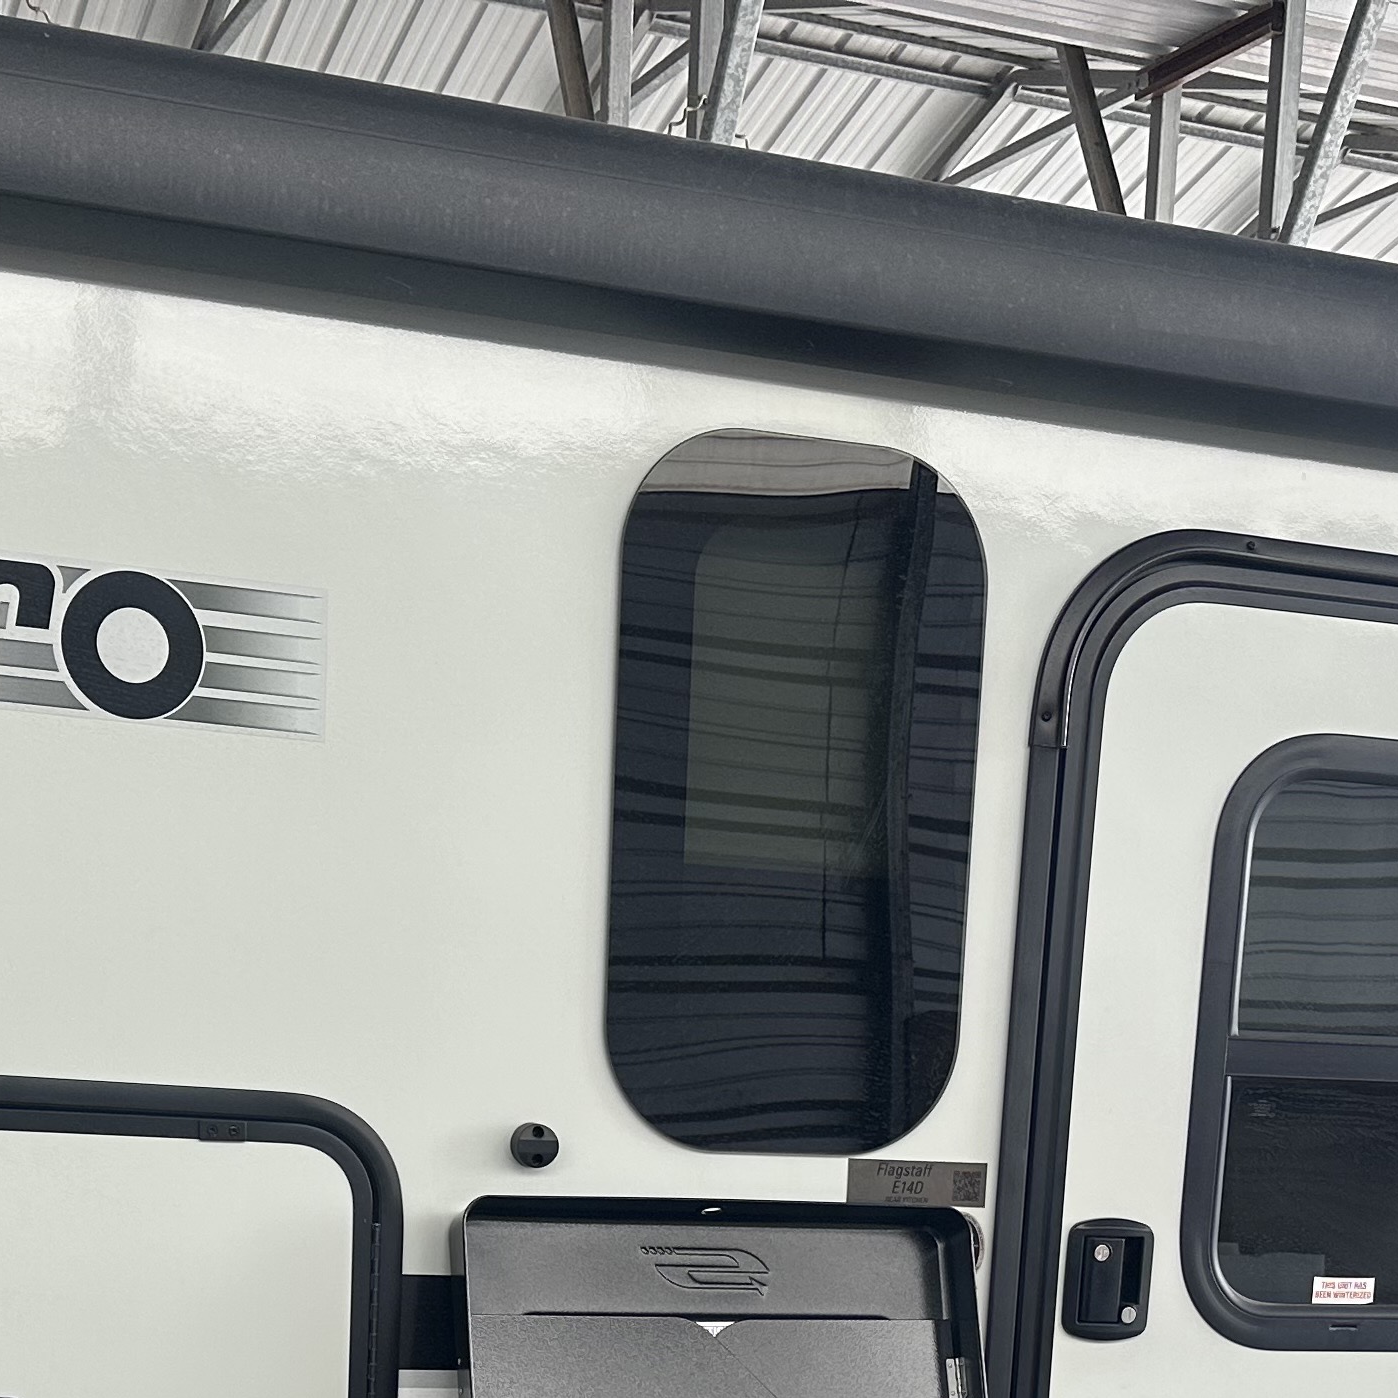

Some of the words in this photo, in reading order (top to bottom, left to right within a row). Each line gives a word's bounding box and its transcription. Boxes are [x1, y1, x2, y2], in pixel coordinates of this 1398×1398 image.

[877, 1162, 934, 1178] Flagstaff
[892, 1181, 924, 1195] E14D
[1315, 1291, 1332, 1299] BEEN
[1333, 1291, 1372, 1299] WINTERIZED
